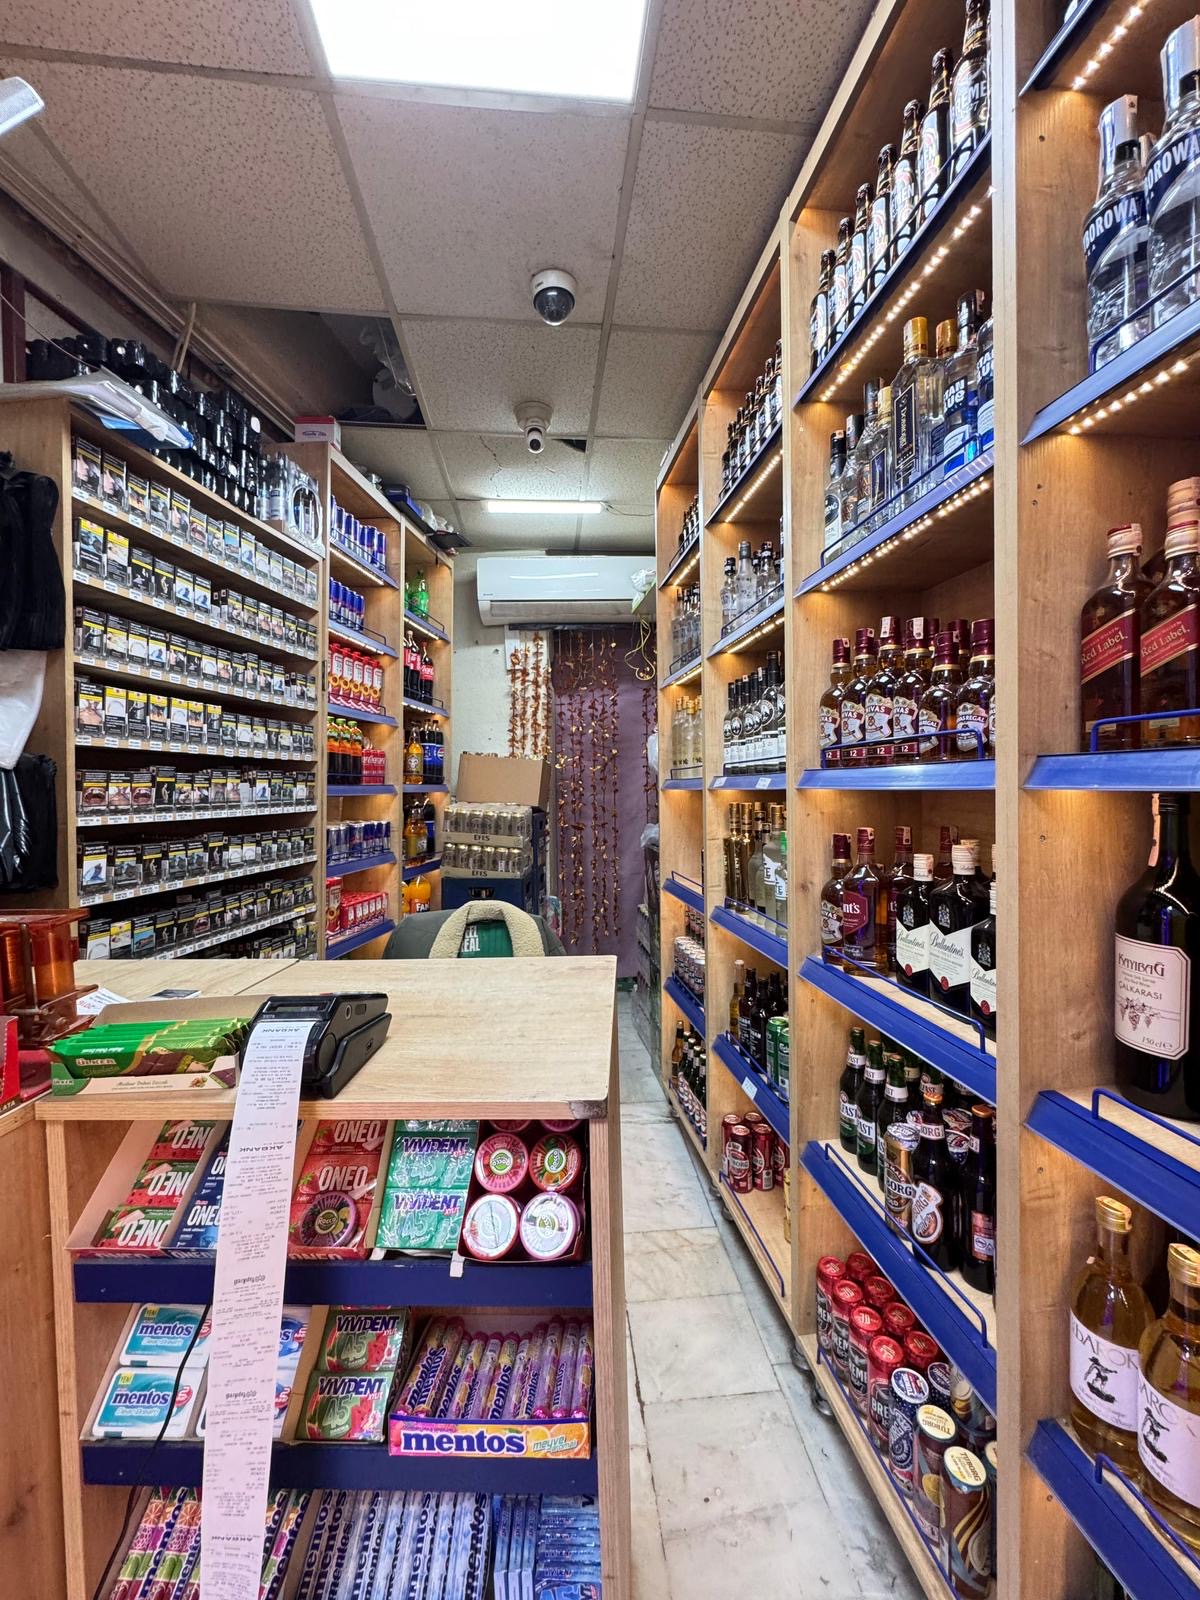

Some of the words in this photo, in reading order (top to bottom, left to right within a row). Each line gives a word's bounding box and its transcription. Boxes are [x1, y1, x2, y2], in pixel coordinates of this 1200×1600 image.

[876, 746, 885, 755] 12
[334, 1120, 381, 1143] ONEO
[319, 1165, 369, 1192] ONEO
[138, 1322, 194, 1336] mentos
[337, 1315, 400, 1333] VIVIDENT
[319, 1377, 385, 1396] VIVIDENT
[112, 1390, 171, 1405] mentos
[402, 1430, 525, 1453] mentos
